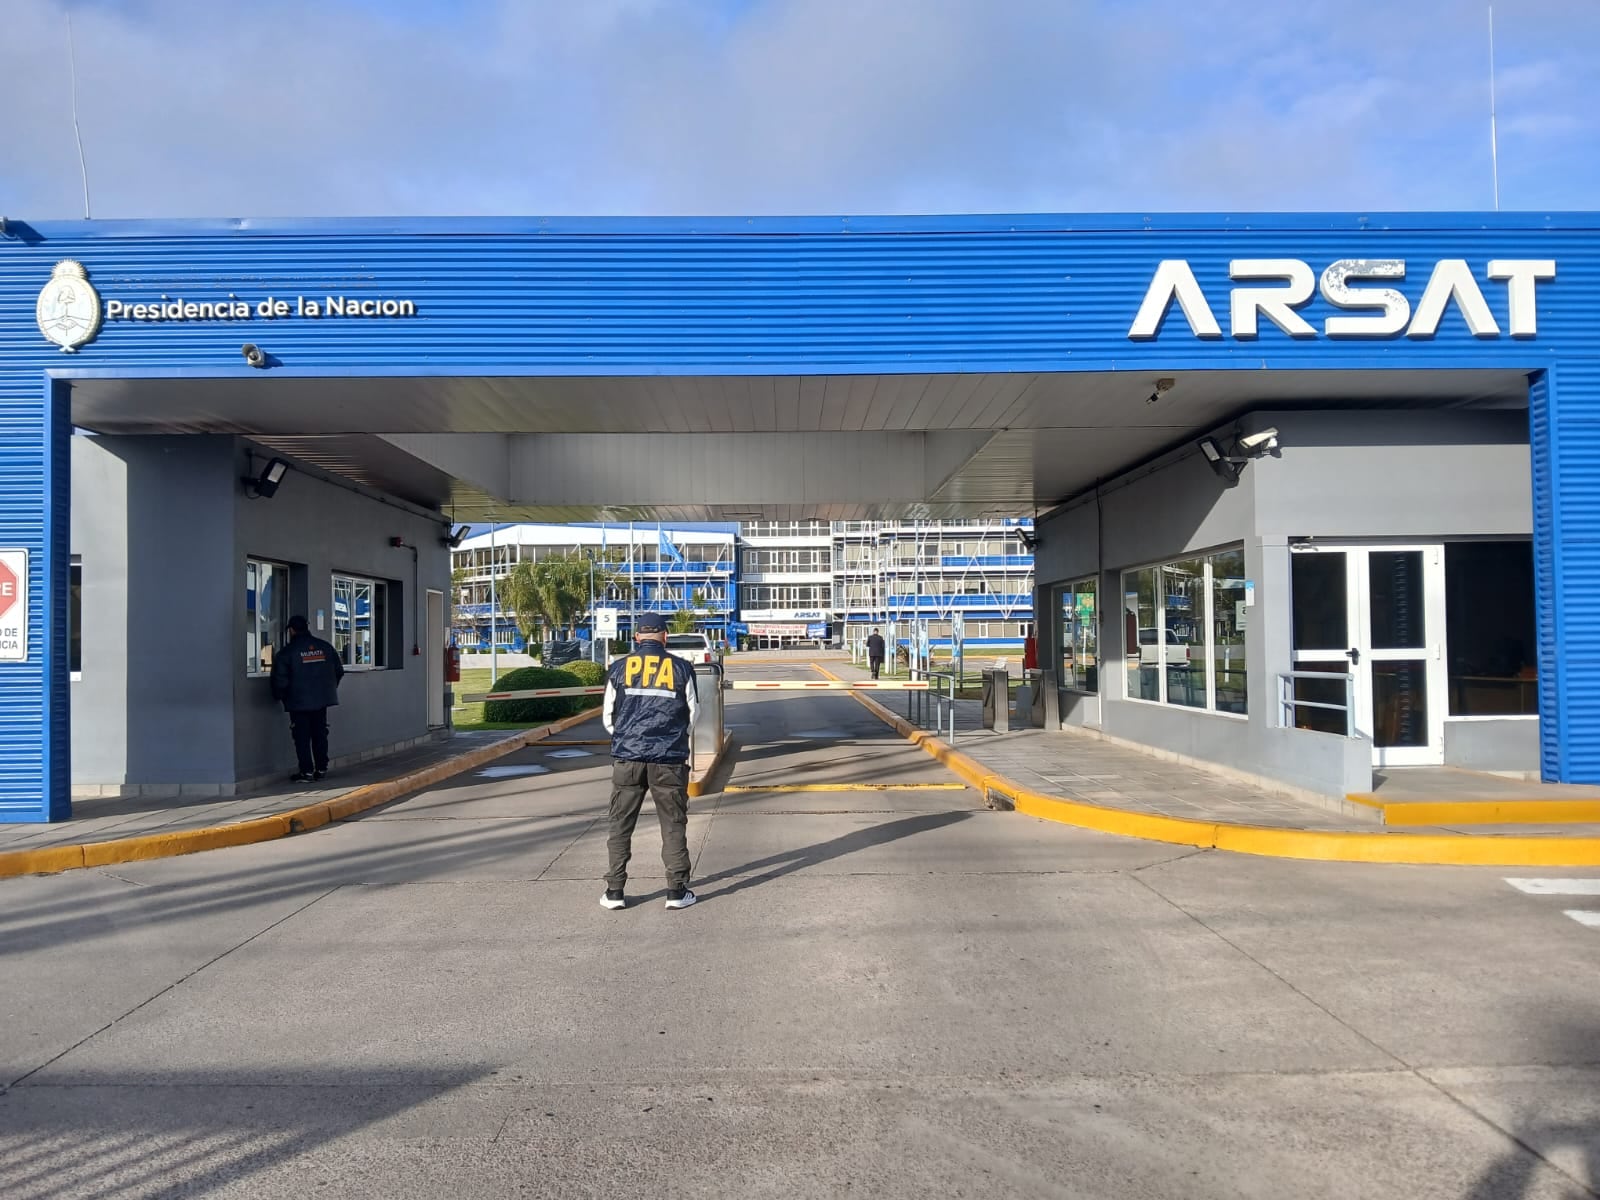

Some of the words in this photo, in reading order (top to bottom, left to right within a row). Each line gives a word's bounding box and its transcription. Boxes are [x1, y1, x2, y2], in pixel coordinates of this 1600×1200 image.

[1127, 259, 1556, 338] ARSAT
[106, 294, 250, 320] Presidencia
[257, 297, 289, 316] de
[297, 296, 320, 317] la
[0, 582, 13, 596] E
[604, 614, 610, 622] 5
[4, 628, 18, 636] DE
[0, 640, 18, 649] CIA
[625, 655, 674, 690] PFA
